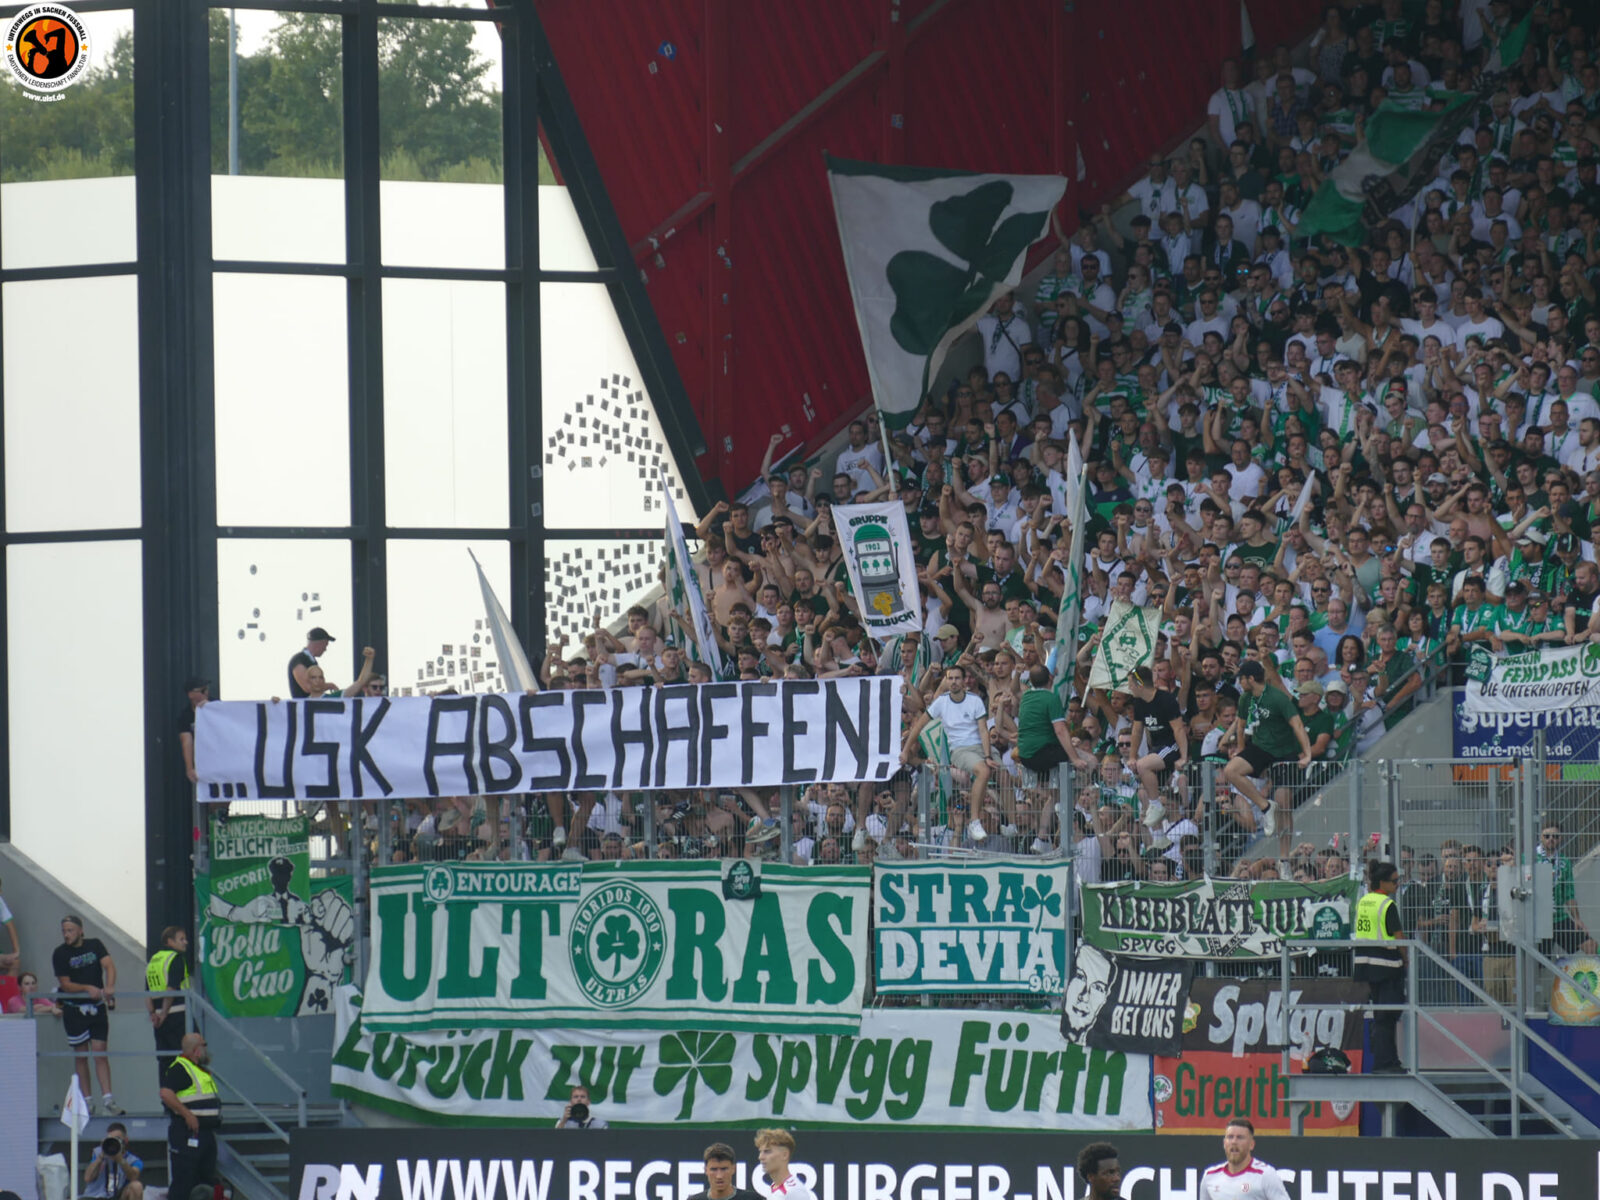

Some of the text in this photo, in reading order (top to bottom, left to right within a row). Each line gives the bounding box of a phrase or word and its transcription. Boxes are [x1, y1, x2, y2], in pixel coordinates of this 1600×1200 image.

[849, 514, 888, 527] GRUPPE
[1502, 657, 1578, 683] FEHLPASS
[1480, 682, 1498, 697] DIE
[423, 678, 892, 796] ABSCHAFFEN!
[216, 838, 273, 858] PFLICHT
[216, 868, 268, 895] SOFORT!
[457, 871, 581, 893] ENTOURAGE
[880, 872, 1031, 923] STRA
[575, 887, 660, 935] HORIDOS 1000
[1098, 888, 1347, 936] KLEEBLATT JUN
[209, 925, 280, 967] Bella
[880, 930, 1059, 982] DEVIA
[1120, 937, 1177, 954] SPVGG
[233, 960, 294, 1000] Ciao
[585, 974, 648, 1002] ULTRAS
[1118, 969, 1182, 1006] IMMER
[1110, 1005, 1175, 1039] BEI UNS
[1208, 984, 1346, 1060] SpVgg
[332, 1012, 1128, 1121] Zurück zur SpVgg Fürth
[1175, 1061, 1322, 1118] Greuth
